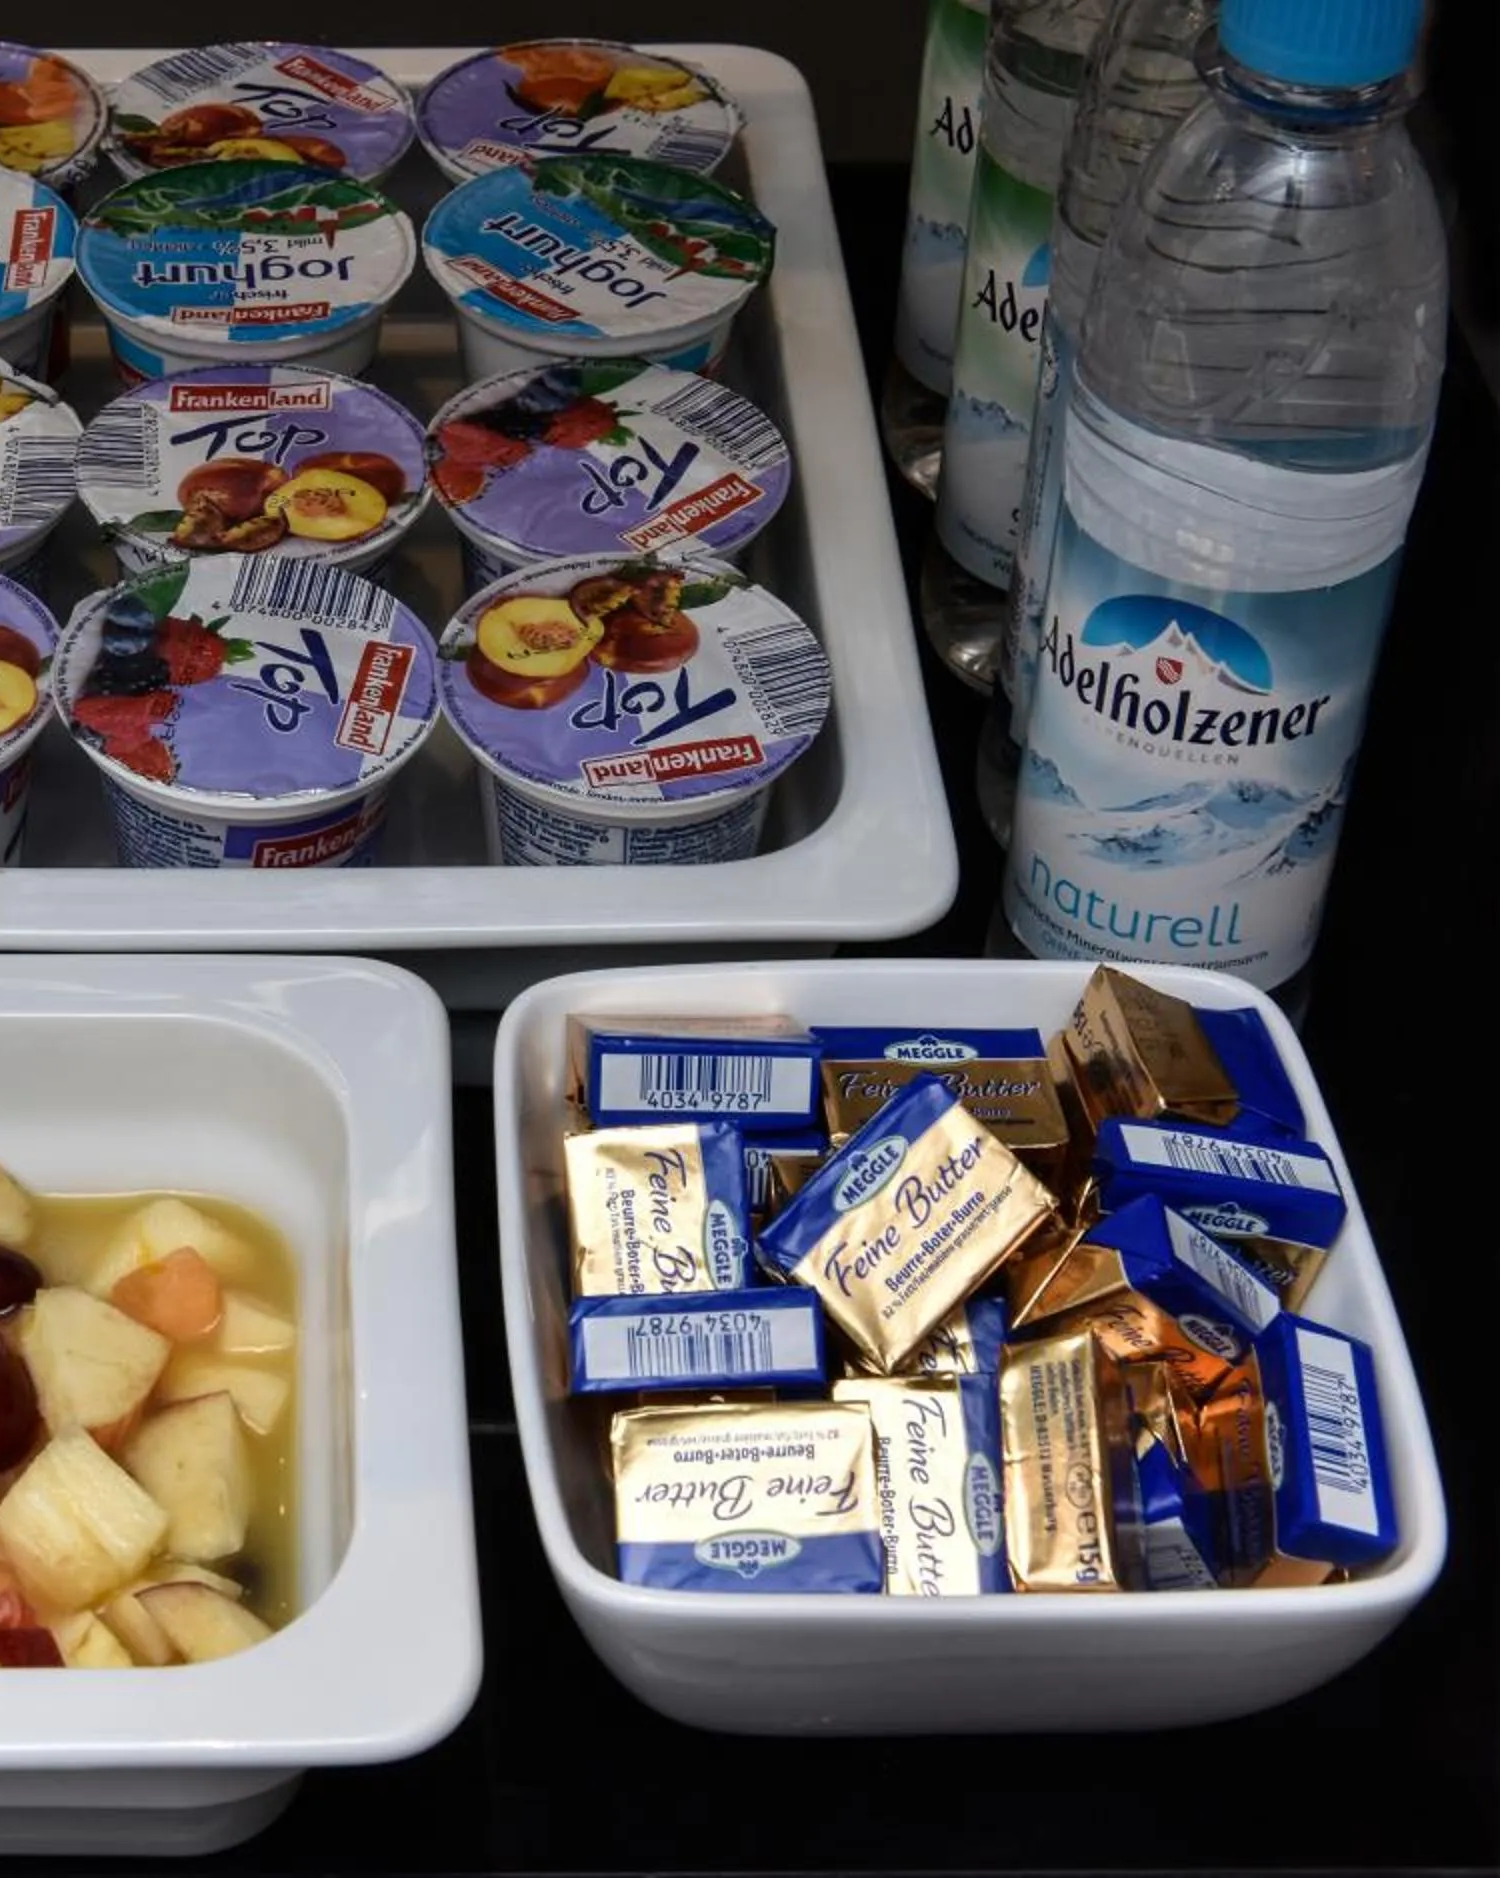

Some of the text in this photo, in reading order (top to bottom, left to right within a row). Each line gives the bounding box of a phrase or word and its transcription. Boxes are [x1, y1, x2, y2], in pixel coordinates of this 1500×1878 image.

[230, 83, 338, 130] Top
[137, 255, 356, 290] Joghurt
[483, 211, 669, 309] Joghurt
[180, 302, 328, 323] Frankenland
[175, 386, 324, 409] Frankenland
[169, 412, 330, 465] Top
[580, 435, 700, 516] Top
[625, 477, 753, 547] Frankenland
[229, 628, 341, 733] Top
[348, 644, 406, 752] Frankenland
[571, 666, 739, 746] Top
[1039, 614, 1332, 748] Adelholzener
[592, 741, 757, 783] Frankenland
[1031, 852, 1243, 948] naturell
[896, 1045, 966, 1060] MEGGLE
[944, 1071, 1043, 1099] Butter
[647, 1092, 764, 1111] 4034 9787
[644, 1148, 687, 1234] Feine
[841, 1143, 901, 1206] MEGGLE
[709, 1211, 733, 1286] MEGGLE
[823, 1223, 902, 1298] Feine
[894, 1136, 985, 1230] Butter
[635, 1312, 763, 1337] 4034 9787
[903, 1397, 948, 1485] Feine
[1337, 1376, 1370, 1491] 4034 9787
[635, 1471, 859, 1521] Feine Butter
[970, 1465, 995, 1543] MEGGLE
[711, 1541, 788, 1559] MEGGLE
[909, 1496, 956, 1600] Butte
